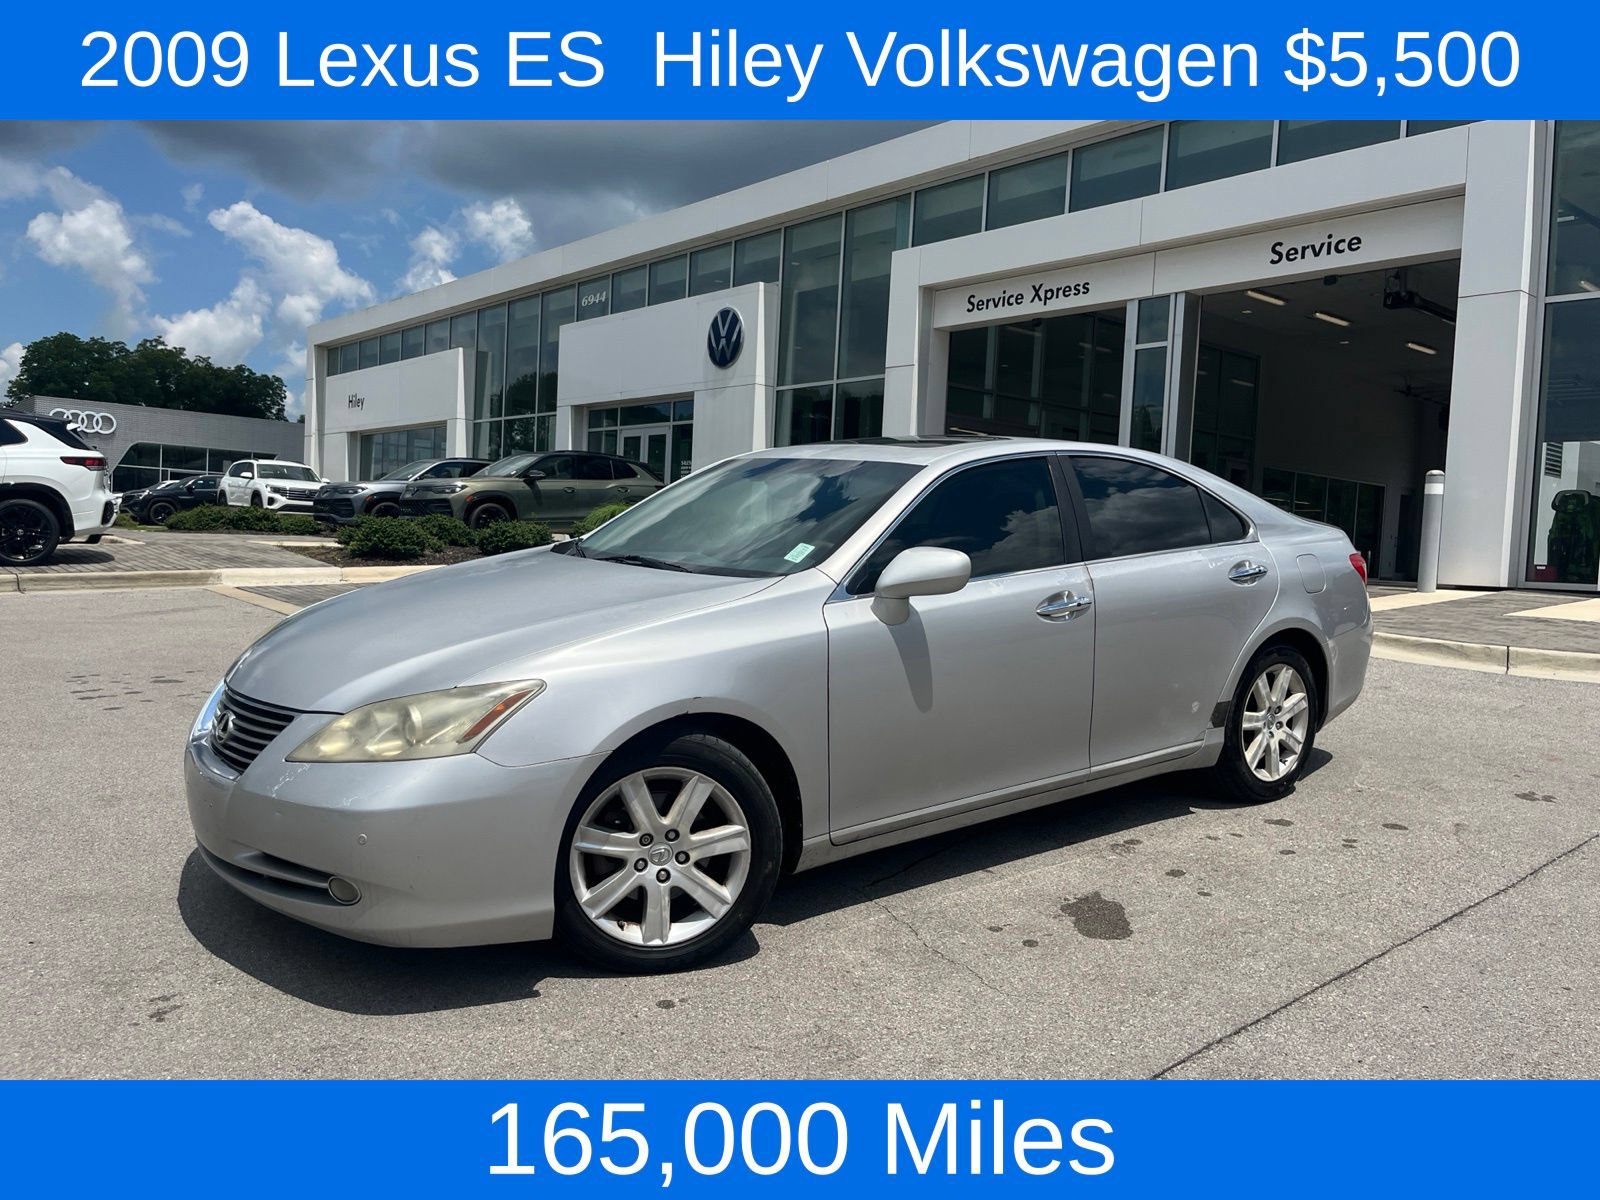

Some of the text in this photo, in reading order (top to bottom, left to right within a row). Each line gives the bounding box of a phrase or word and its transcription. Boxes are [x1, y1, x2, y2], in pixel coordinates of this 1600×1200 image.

[1269, 233, 1362, 265] Service
[581, 290, 607, 307] 6944
[966, 281, 1091, 313] Service Xpress
[347, 392, 365, 411] Hiley
